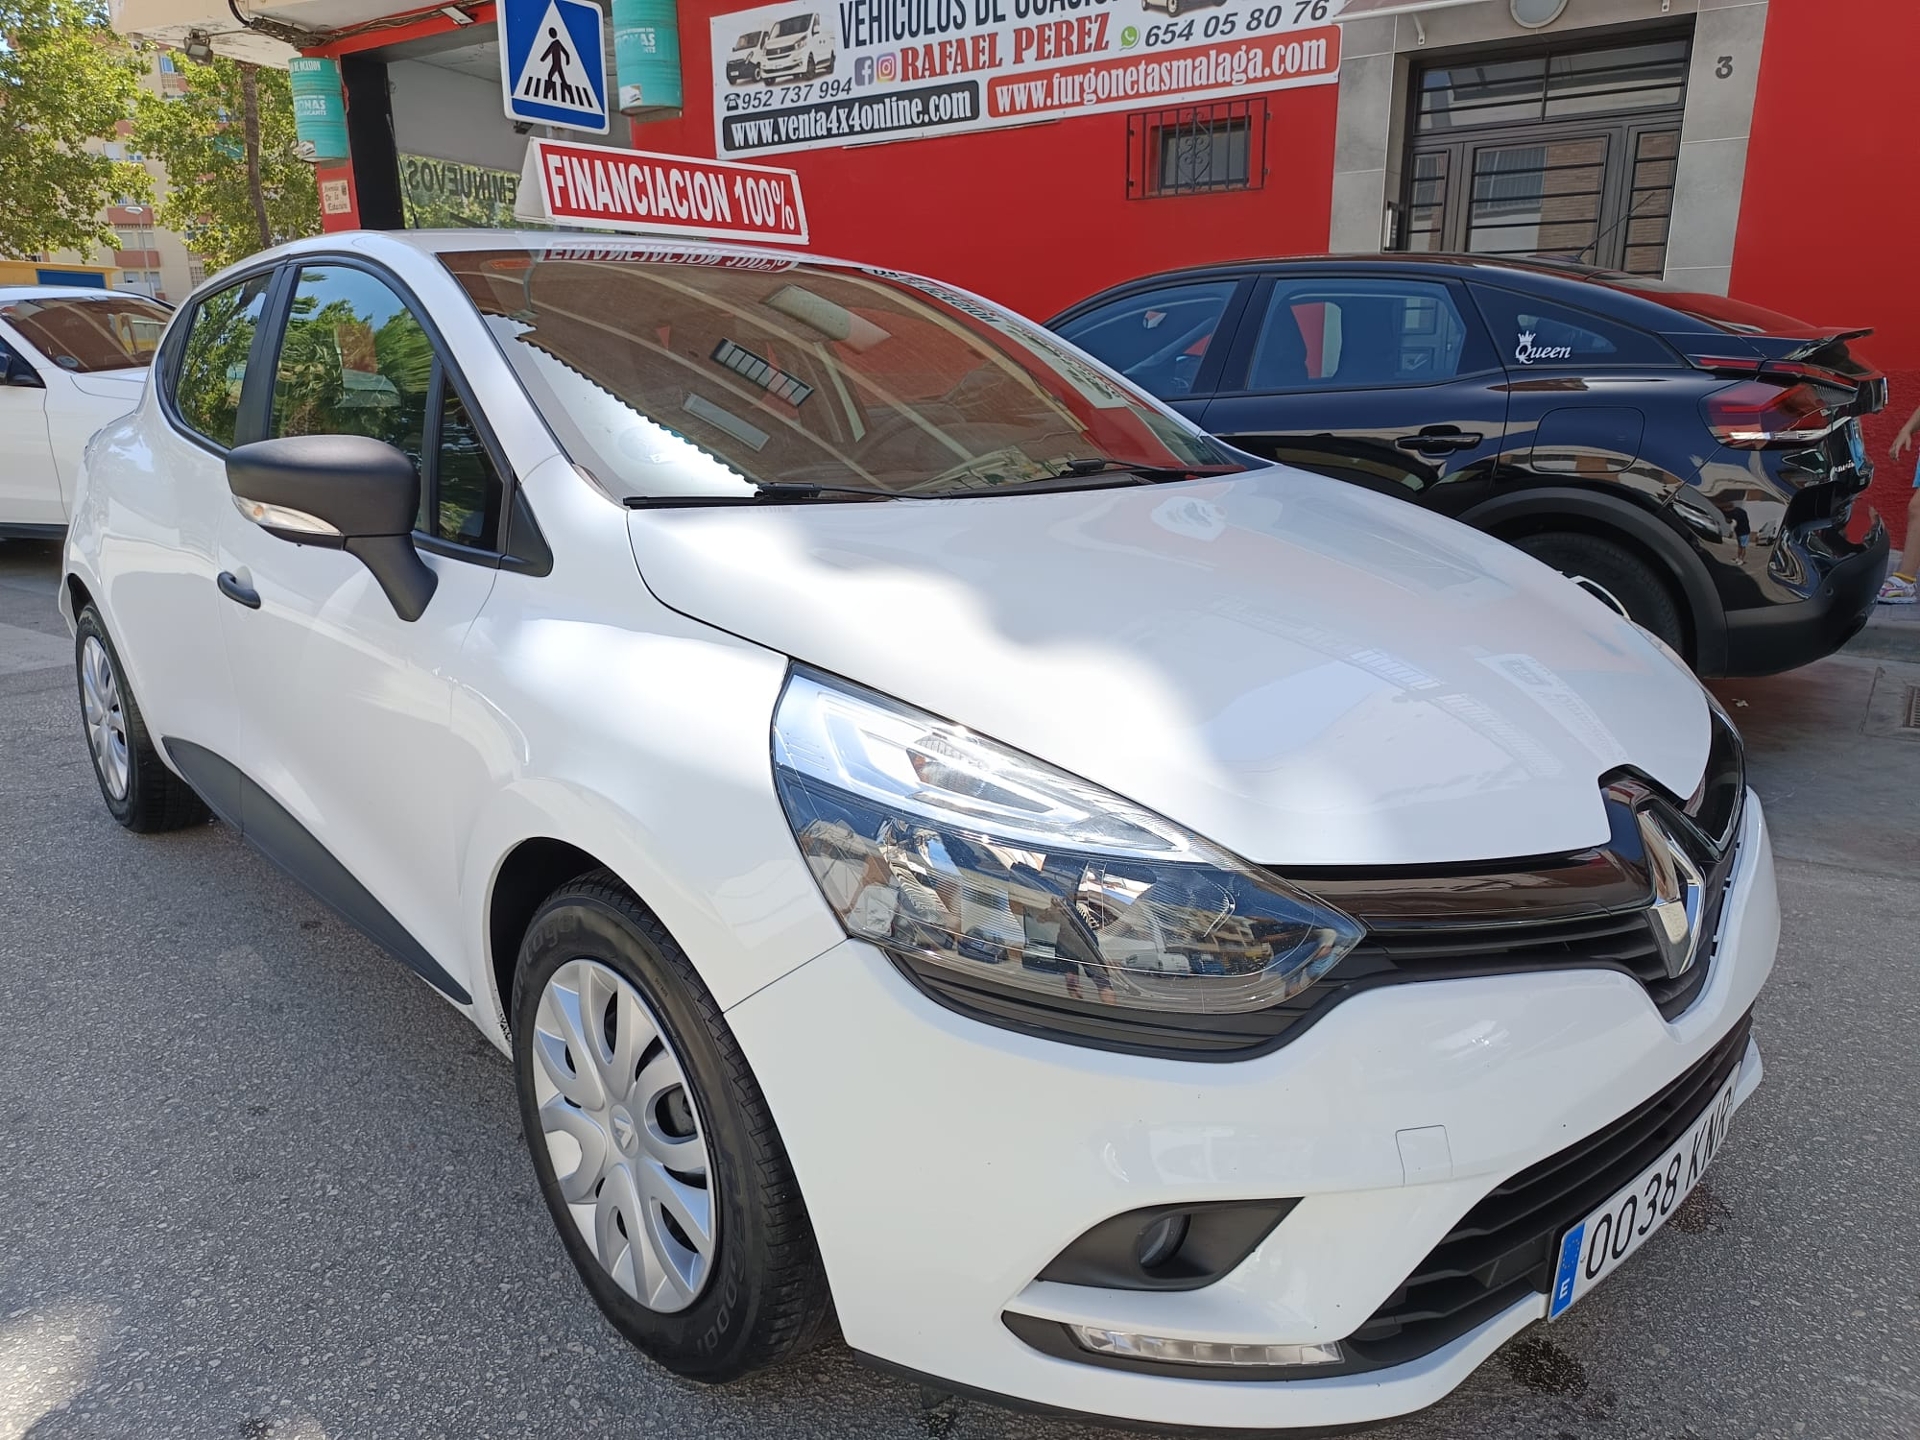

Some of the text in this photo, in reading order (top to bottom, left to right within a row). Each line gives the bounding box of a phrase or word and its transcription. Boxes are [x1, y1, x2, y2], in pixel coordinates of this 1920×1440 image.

[839, 0, 966, 49] VEHICULOS
[900, 12, 1110, 82] RAFAEL PEREZ
[1145, 0, 1329, 47] 654 05 80 76
[995, 37, 1327, 114] www.furgonetasmalaga.com
[1715, 55, 1733, 79] 3
[742, 77, 853, 110] 952 737 994
[731, 90, 972, 148] www.venta4x4online.com
[546, 153, 795, 231] FINANCIACION 100%
[1515, 342, 1572, 365] Queen
[1585, 1152, 1682, 1280] 0038
[1558, 1277, 1571, 1300] E
